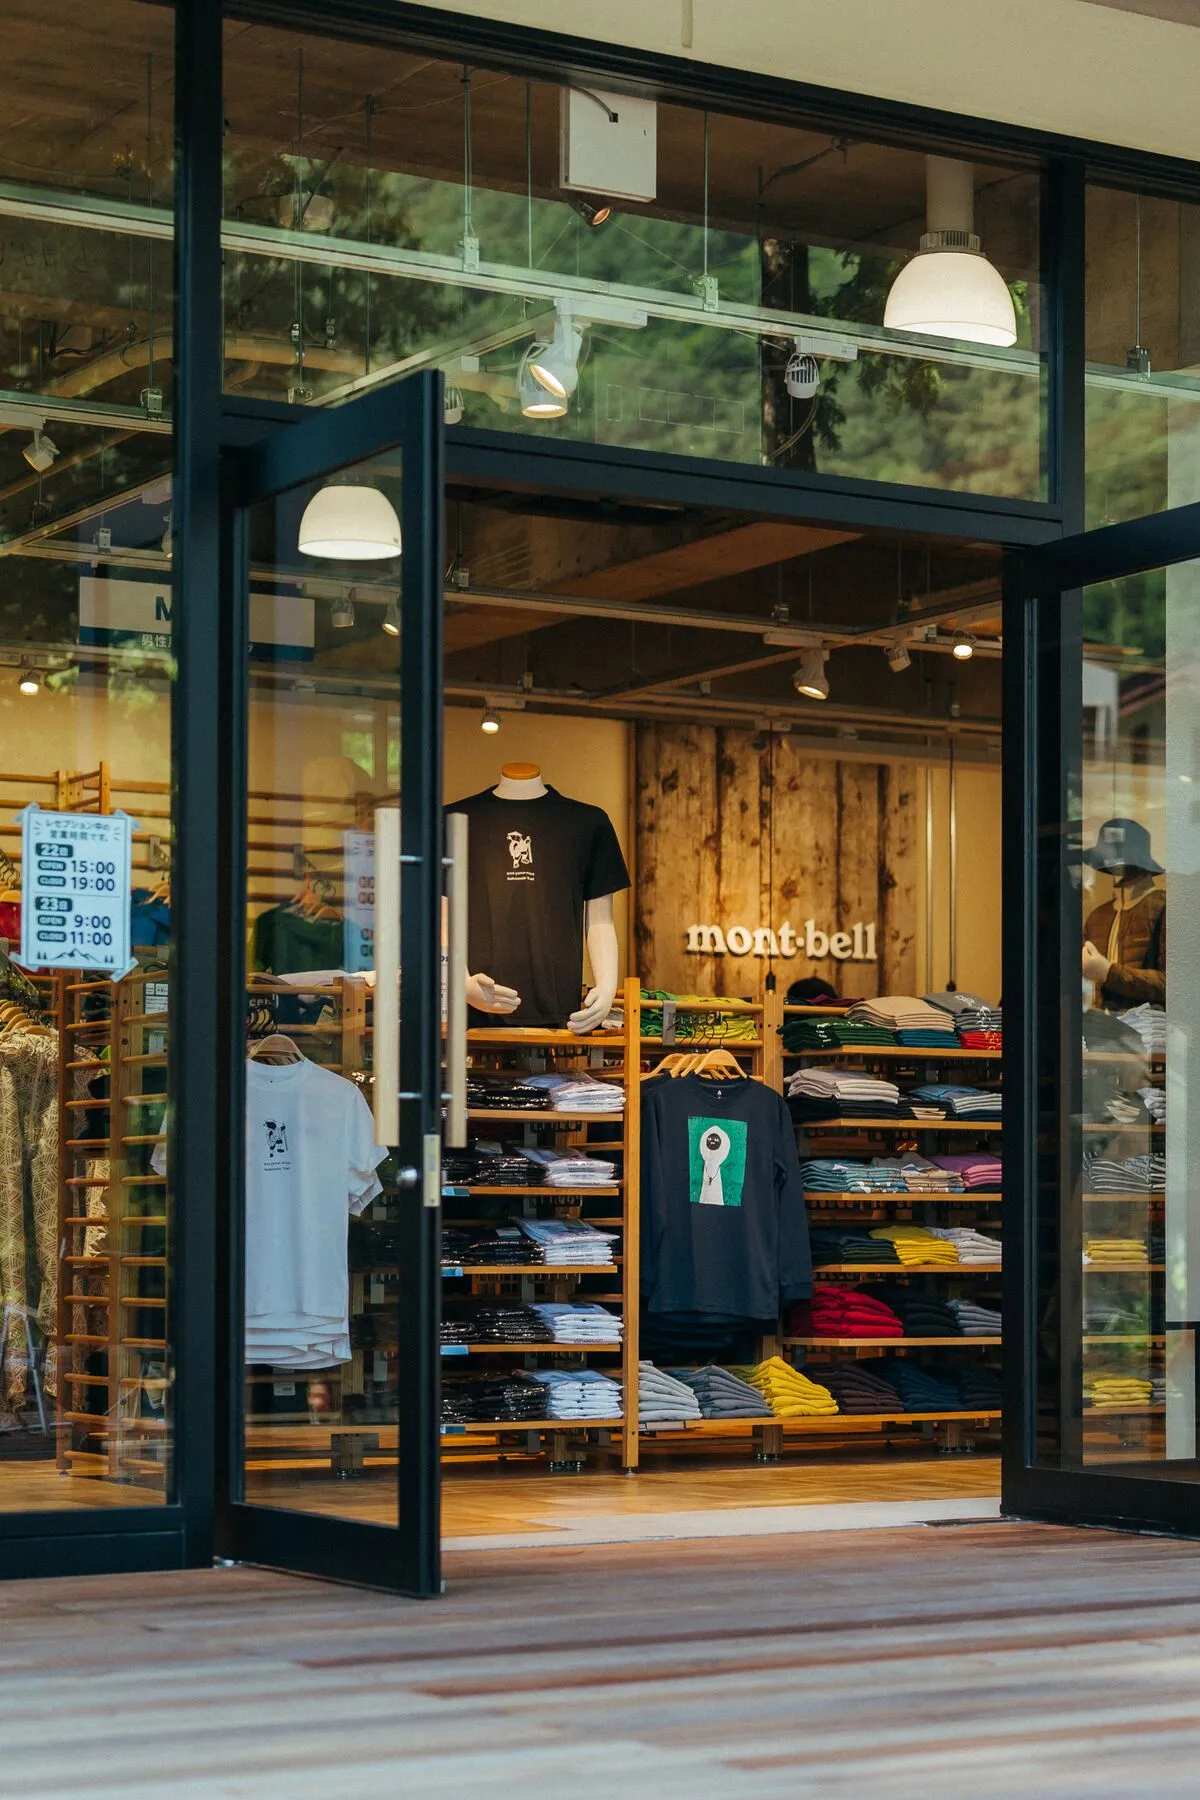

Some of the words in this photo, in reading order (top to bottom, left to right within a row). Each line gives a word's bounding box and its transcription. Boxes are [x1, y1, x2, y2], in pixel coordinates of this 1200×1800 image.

[71, 860, 115, 875] 15:00
[71, 876, 115, 891] 19:00
[74, 914, 111, 929] 9:00
[70, 932, 113, 946] 11:00
